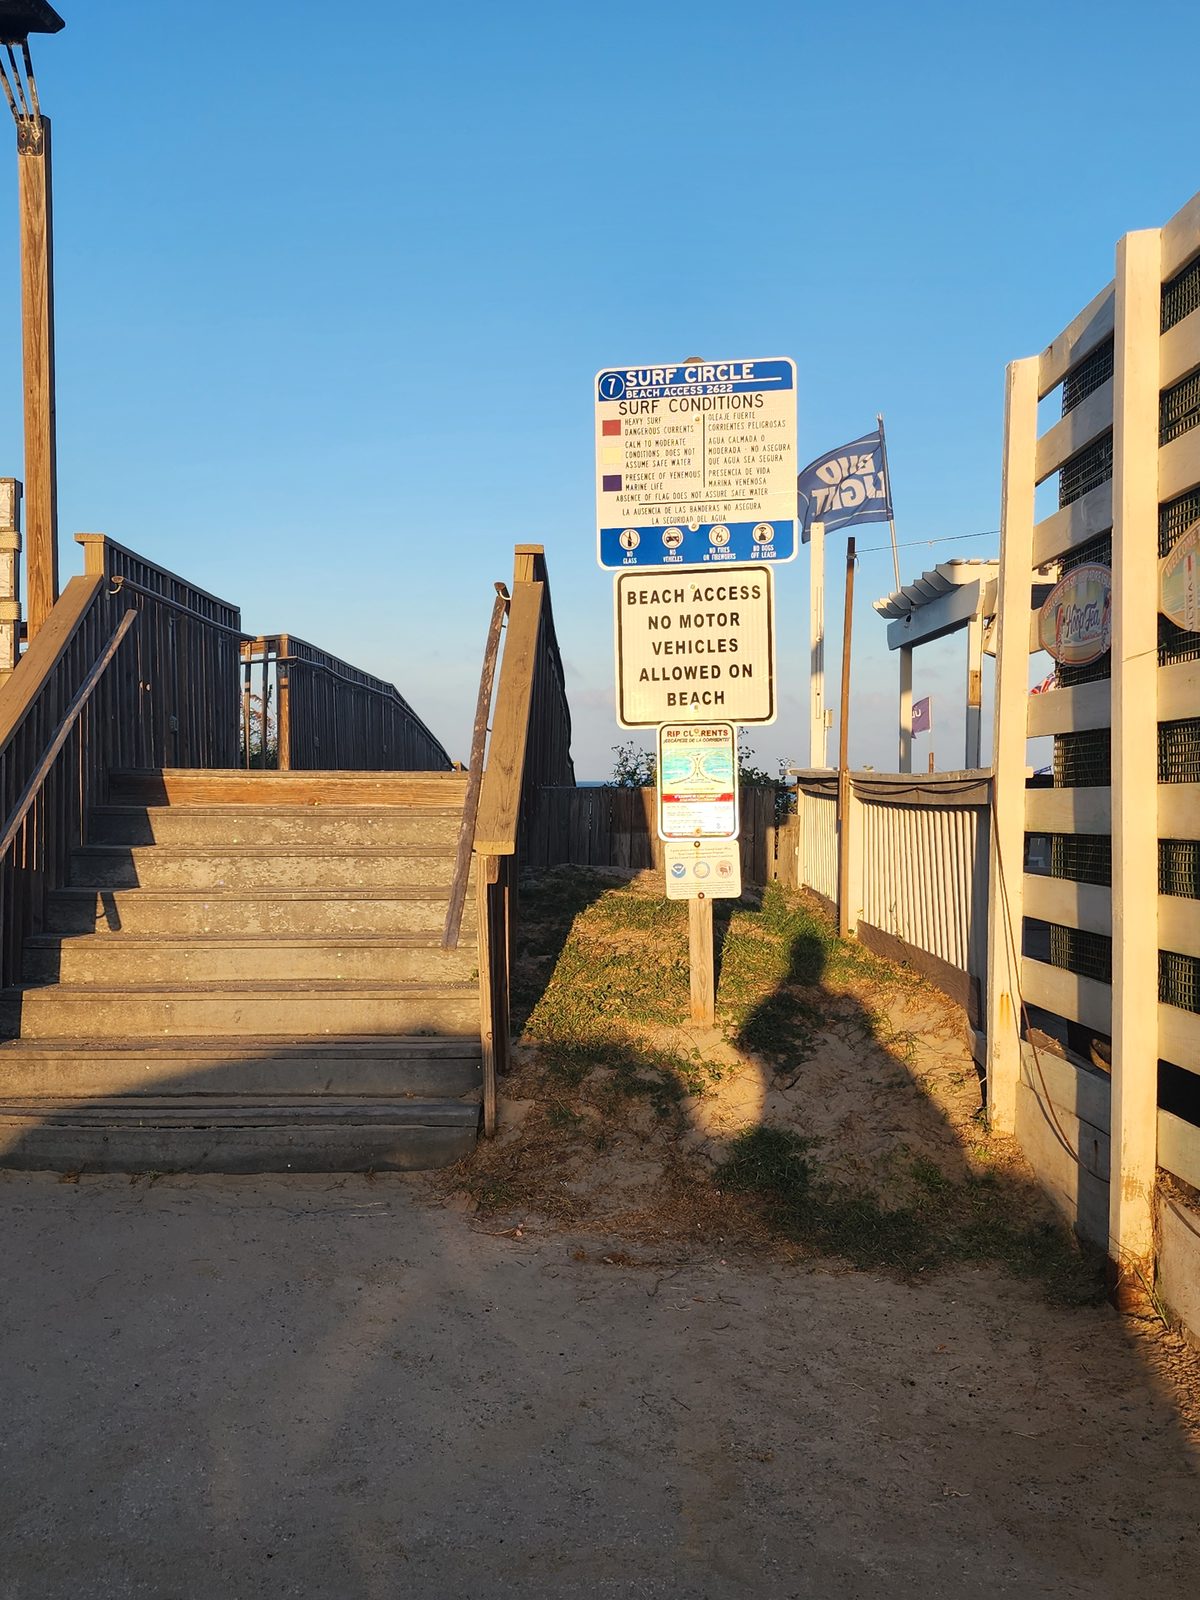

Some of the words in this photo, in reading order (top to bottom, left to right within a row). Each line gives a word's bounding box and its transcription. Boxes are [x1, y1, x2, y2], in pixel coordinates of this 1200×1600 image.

[626, 369, 677, 387] SURF
[684, 364, 754, 383] CIRCLE
[607, 378, 615, 395] 7
[626, 388, 660, 399] BEACH
[664, 386, 702, 396] ACCESS
[706, 384, 733, 393] 2622
[618, 399, 660, 416] SURF
[669, 394, 764, 413] CONDITIONS
[625, 418, 643, 426] HEAVY
[708, 412, 730, 421] OLEAJE
[625, 427, 661, 436] DANGEROUS
[664, 425, 694, 434] CURRENTS
[708, 422, 744, 431] CORRIENTES
[748, 420, 786, 429] PELIGROSAS
[655, 438, 686, 447] MODERATE
[728, 435, 757, 444] CALMADA
[665, 449, 680, 457] DOES
[708, 446, 741, 455] MODERADA
[751, 445, 759, 453] NO
[762, 444, 791, 452] ASEGURA
[626, 460, 649, 468] ASSUME
[652, 459, 668, 468] SAFE
[671, 458, 691, 466] WATER
[708, 457, 720, 465] QUE
[723, 456, 740, 464] AGUA
[759, 454, 783, 462] SEGURA
[626, 473, 655, 481] PRESENCE
[670, 470, 701, 479] VENEMOUS
[709, 468, 741, 477] PRESENCIA
[756, 467, 770, 475] VIDA
[626, 483, 647, 491] MARINE
[651, 482, 663, 490] LIFE
[735, 477, 767, 486] VENENOSA
[616, 494, 641, 502] ABSENCE
[673, 492, 687, 500] DOES
[691, 491, 701, 499] NOT
[705, 490, 727, 498] ASSURE
[731, 489, 746, 497] SAFE
[749, 488, 768, 496] WATER
[633, 507, 661, 515] AUSENCIA
[664, 506, 671, 514] DE
[735, 503, 762, 511] ASEGURA
[652, 517, 659, 525] LA
[663, 516, 693, 524] SEGURIDAD
[711, 514, 726, 522] AGUA
[627, 589, 684, 605] BEACH
[692, 585, 761, 602] ACCESS
[648, 615, 671, 630] NO
[679, 612, 740, 629] MOTOR
[652, 638, 738, 655] VEHICLES
[639, 665, 721, 682] ALLOWED
[729, 664, 753, 678] ON
[667, 691, 724, 706] BEACH
[683, 729, 728, 737] CURENTS
